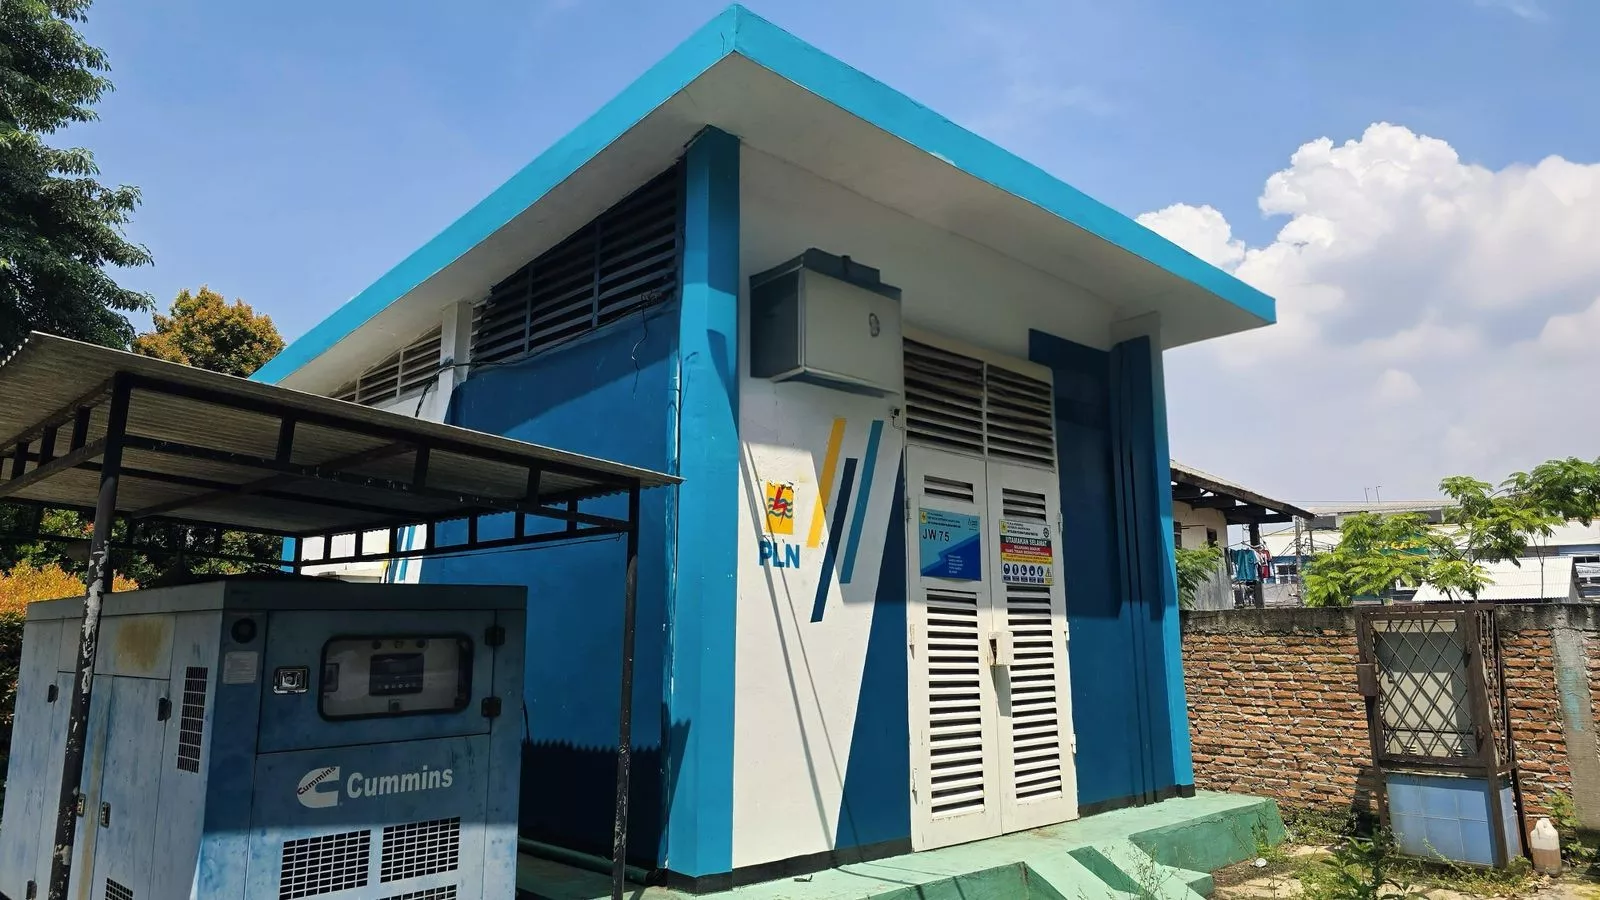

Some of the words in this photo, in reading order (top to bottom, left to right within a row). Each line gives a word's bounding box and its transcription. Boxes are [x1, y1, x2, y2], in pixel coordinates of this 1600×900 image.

[923, 528, 937, 540] JW
[939, 530, 950, 542] 75
[759, 541, 800, 569] PLN
[297, 765, 337, 796] Cummins
[347, 765, 453, 799] Cummins
